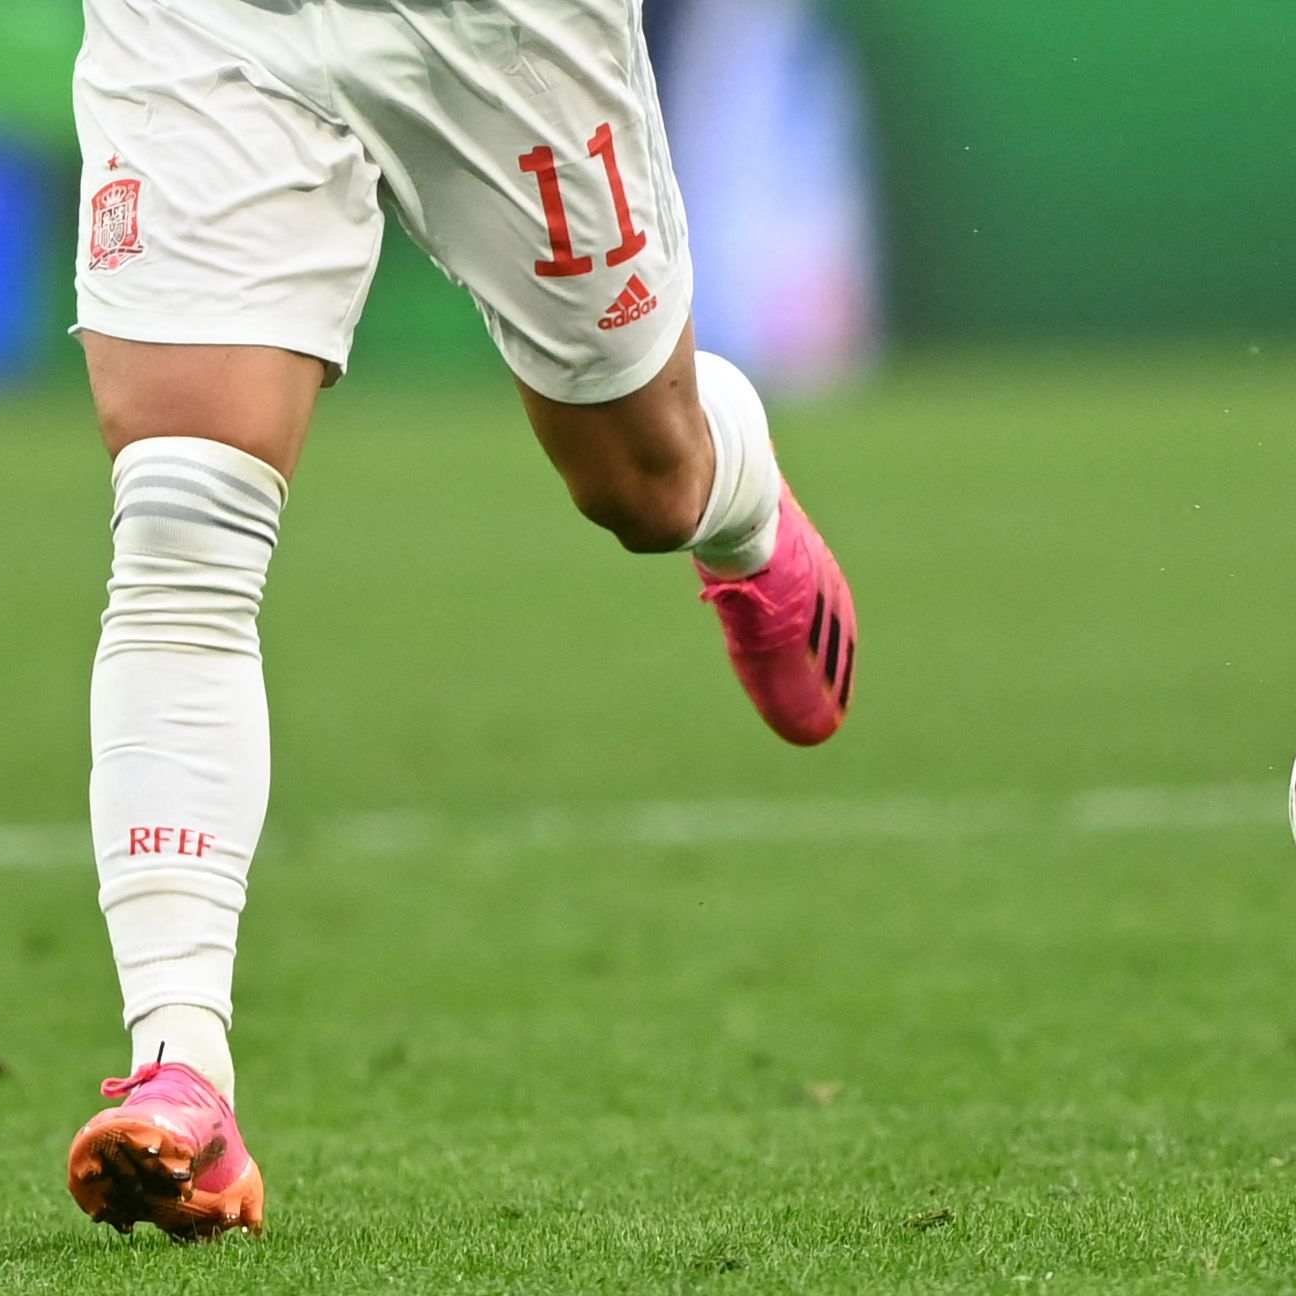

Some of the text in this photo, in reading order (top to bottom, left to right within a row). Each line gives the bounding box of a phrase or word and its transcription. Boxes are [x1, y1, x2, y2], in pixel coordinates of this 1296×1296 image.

[518, 122, 647, 277] 11
[597, 295, 657, 331] adidas
[129, 826, 215, 858] RFEF
